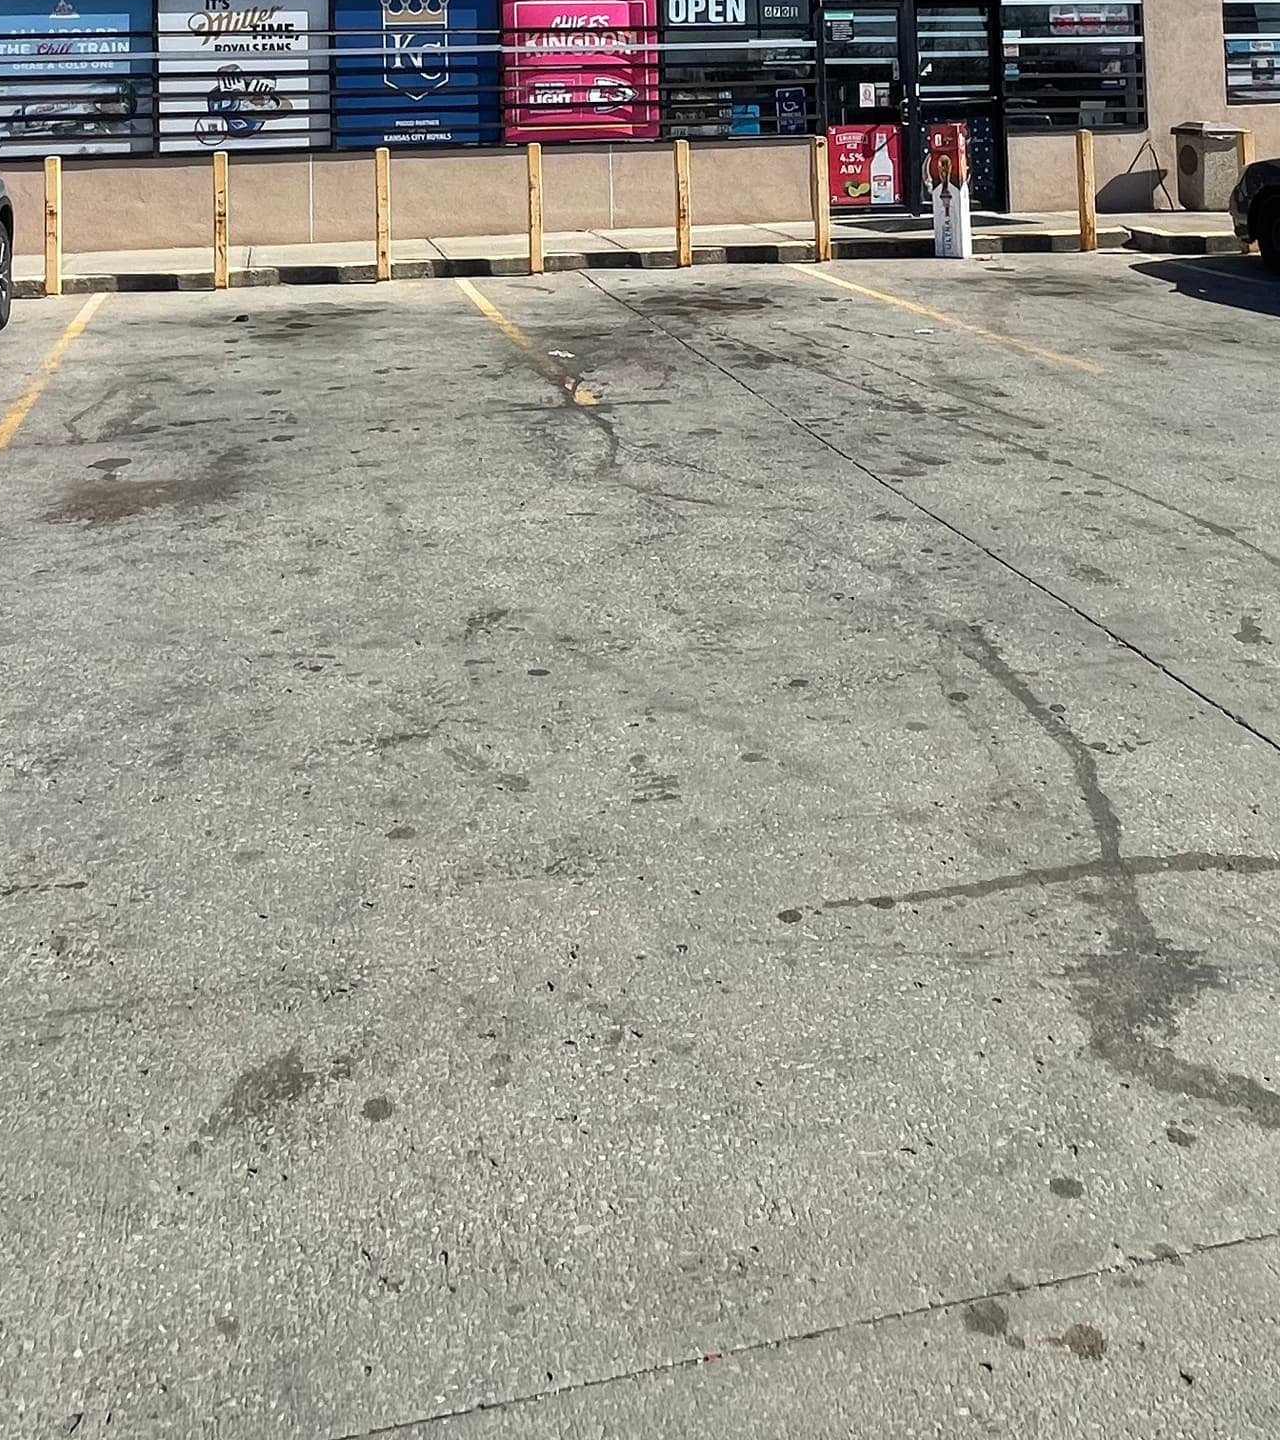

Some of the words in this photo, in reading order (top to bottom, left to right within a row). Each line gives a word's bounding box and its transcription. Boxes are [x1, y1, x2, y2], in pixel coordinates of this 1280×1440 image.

[188, 5, 283, 46] Miller
[77, 42, 130, 53] TRAIN
[524, 31, 638, 58] KINGDOM
[58, 61, 88, 70] COLD
[90, 60, 115, 69] ONE
[839, 152, 865, 162] 4.5%
[839, 164, 862, 174] ABV
